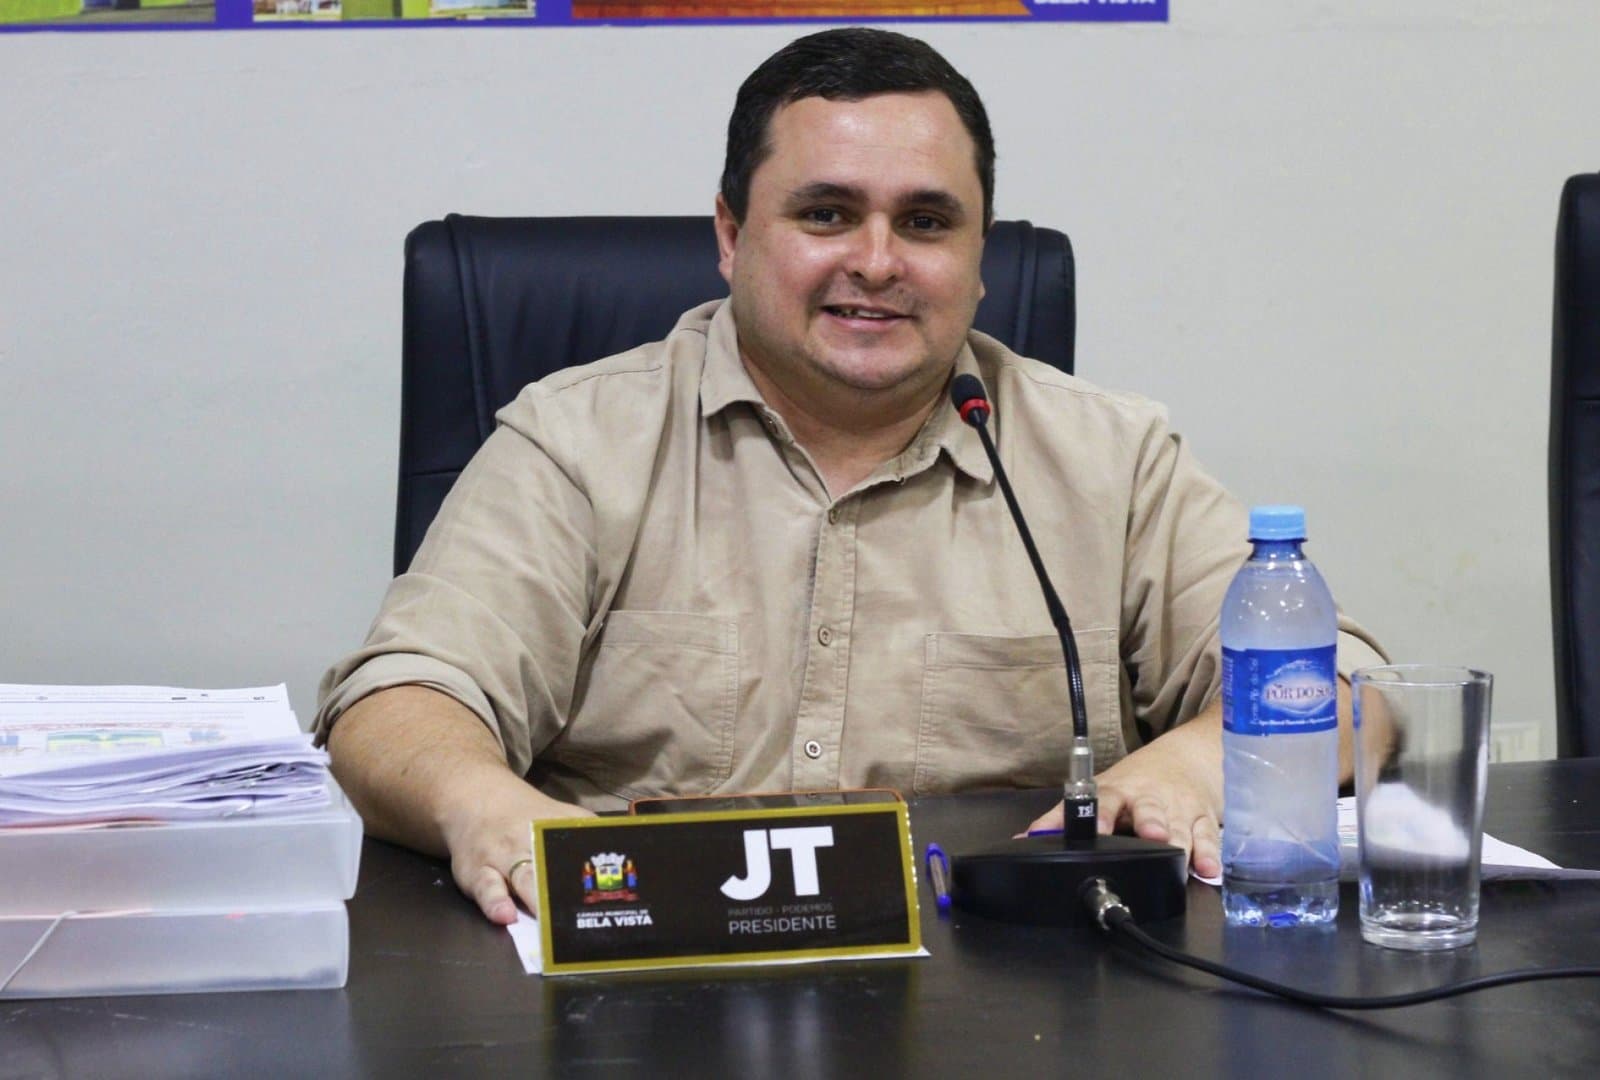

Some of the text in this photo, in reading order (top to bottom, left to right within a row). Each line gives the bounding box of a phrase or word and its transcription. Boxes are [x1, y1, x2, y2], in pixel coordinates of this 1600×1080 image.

[719, 826, 835, 901] JT
[727, 906, 774, 917] PARTIDO
[781, 902, 833, 914] PODEMOS
[577, 914, 653, 929] BELA VISTA
[728, 914, 837, 935] PRESIDENTE
